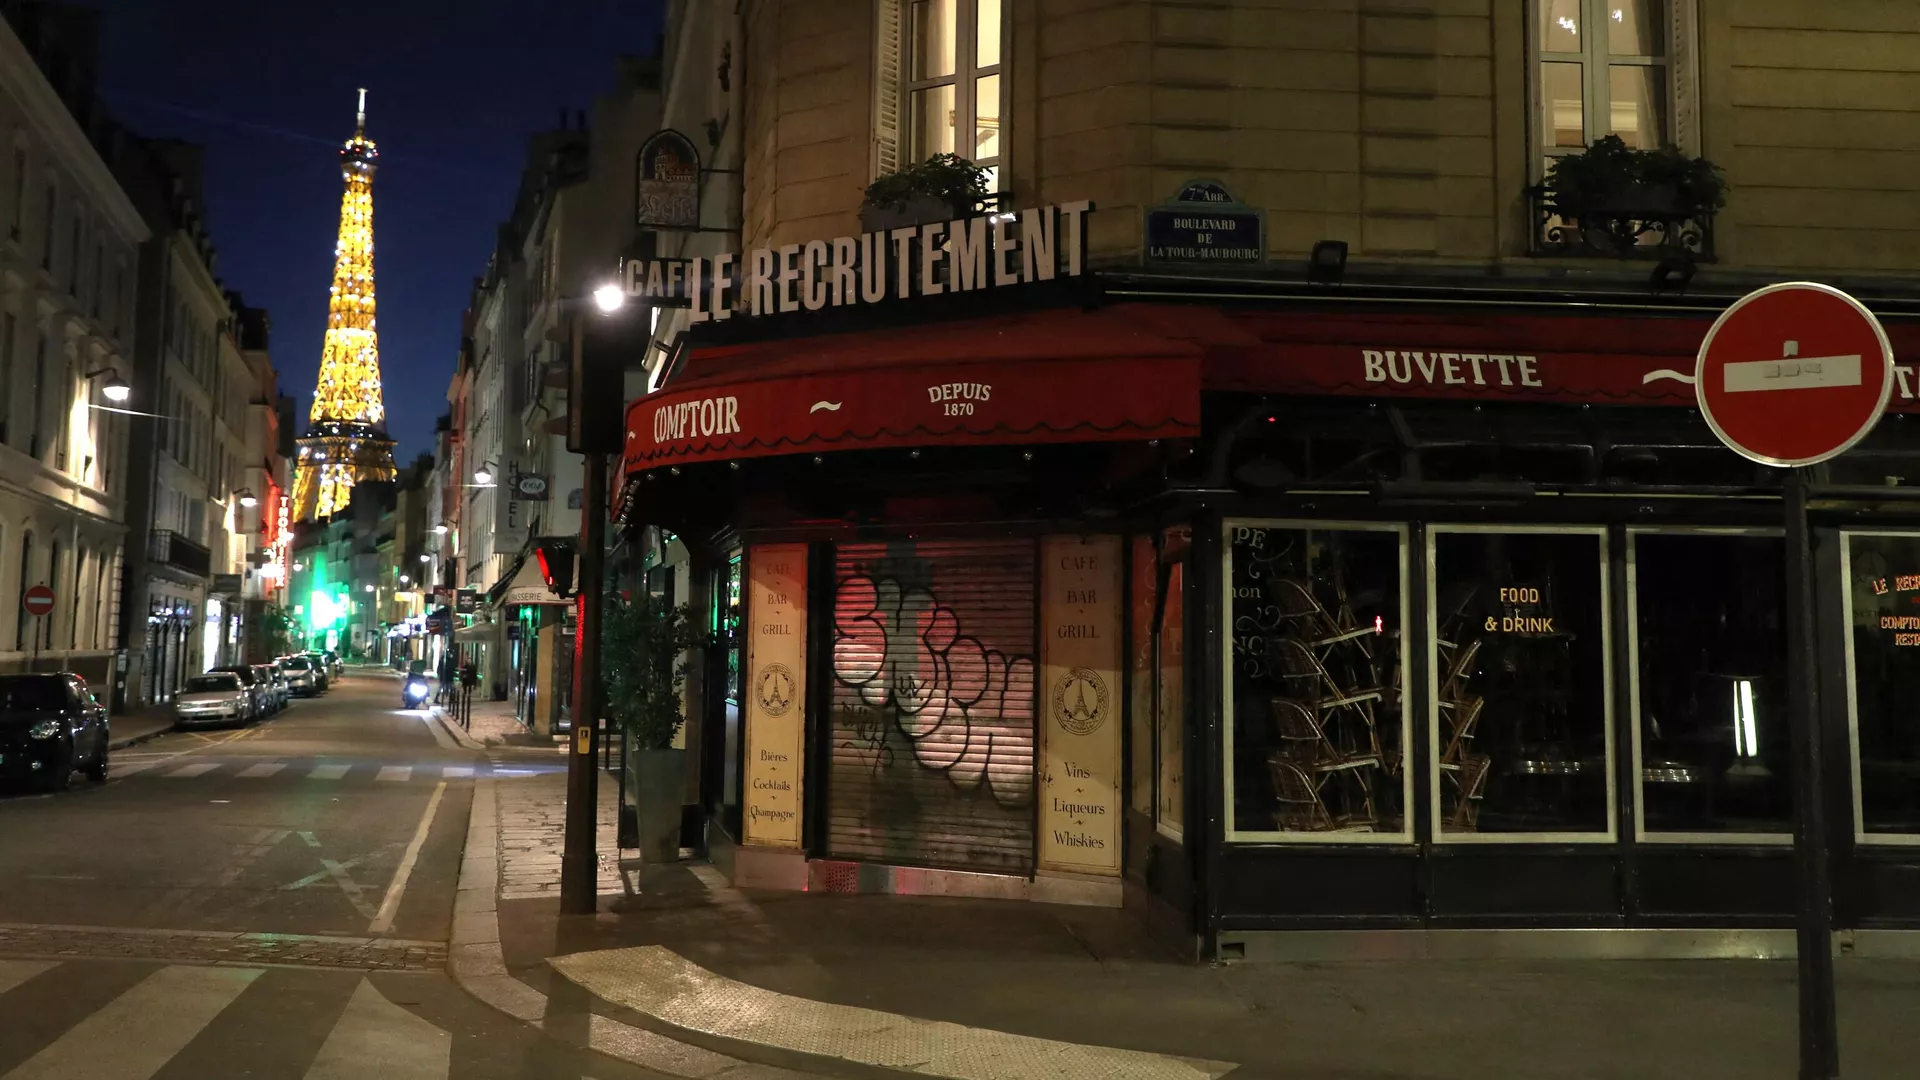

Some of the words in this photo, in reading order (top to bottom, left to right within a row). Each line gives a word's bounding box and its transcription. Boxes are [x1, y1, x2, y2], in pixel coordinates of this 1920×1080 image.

[1173, 218, 1236, 230] BOULEVARD
[1197, 233, 1213, 244] DE
[1150, 246, 1164, 257] LA
[1166, 246, 1259, 259] TOUR-MAUBOURG
[690, 253, 733, 322] LE
[751, 200, 1091, 316] RECRUTEMENT
[1362, 349, 1542, 387] BUVETTE
[927, 382, 992, 403] DEPUIS
[944, 402, 974, 416] 1870
[653, 396, 741, 444] COMPTOIR
[1060, 556, 1099, 570] CAFE
[1872, 577, 1889, 596] LE
[767, 593, 788, 605] BAR
[1066, 589, 1097, 604] BAR
[1500, 587, 1539, 603] FOOD
[761, 624, 791, 635] GRILL
[1057, 624, 1100, 639] GRILL
[1484, 616, 1498, 632] &
[1502, 616, 1554, 632] DRINK
[760, 749, 788, 762] Bières
[1064, 761, 1091, 779] Vins
[753, 777, 791, 791] Cocktails
[750, 804, 795, 822] Champagne
[1053, 797, 1106, 818] Liqueurs
[1053, 830, 1105, 849] Whiskies
